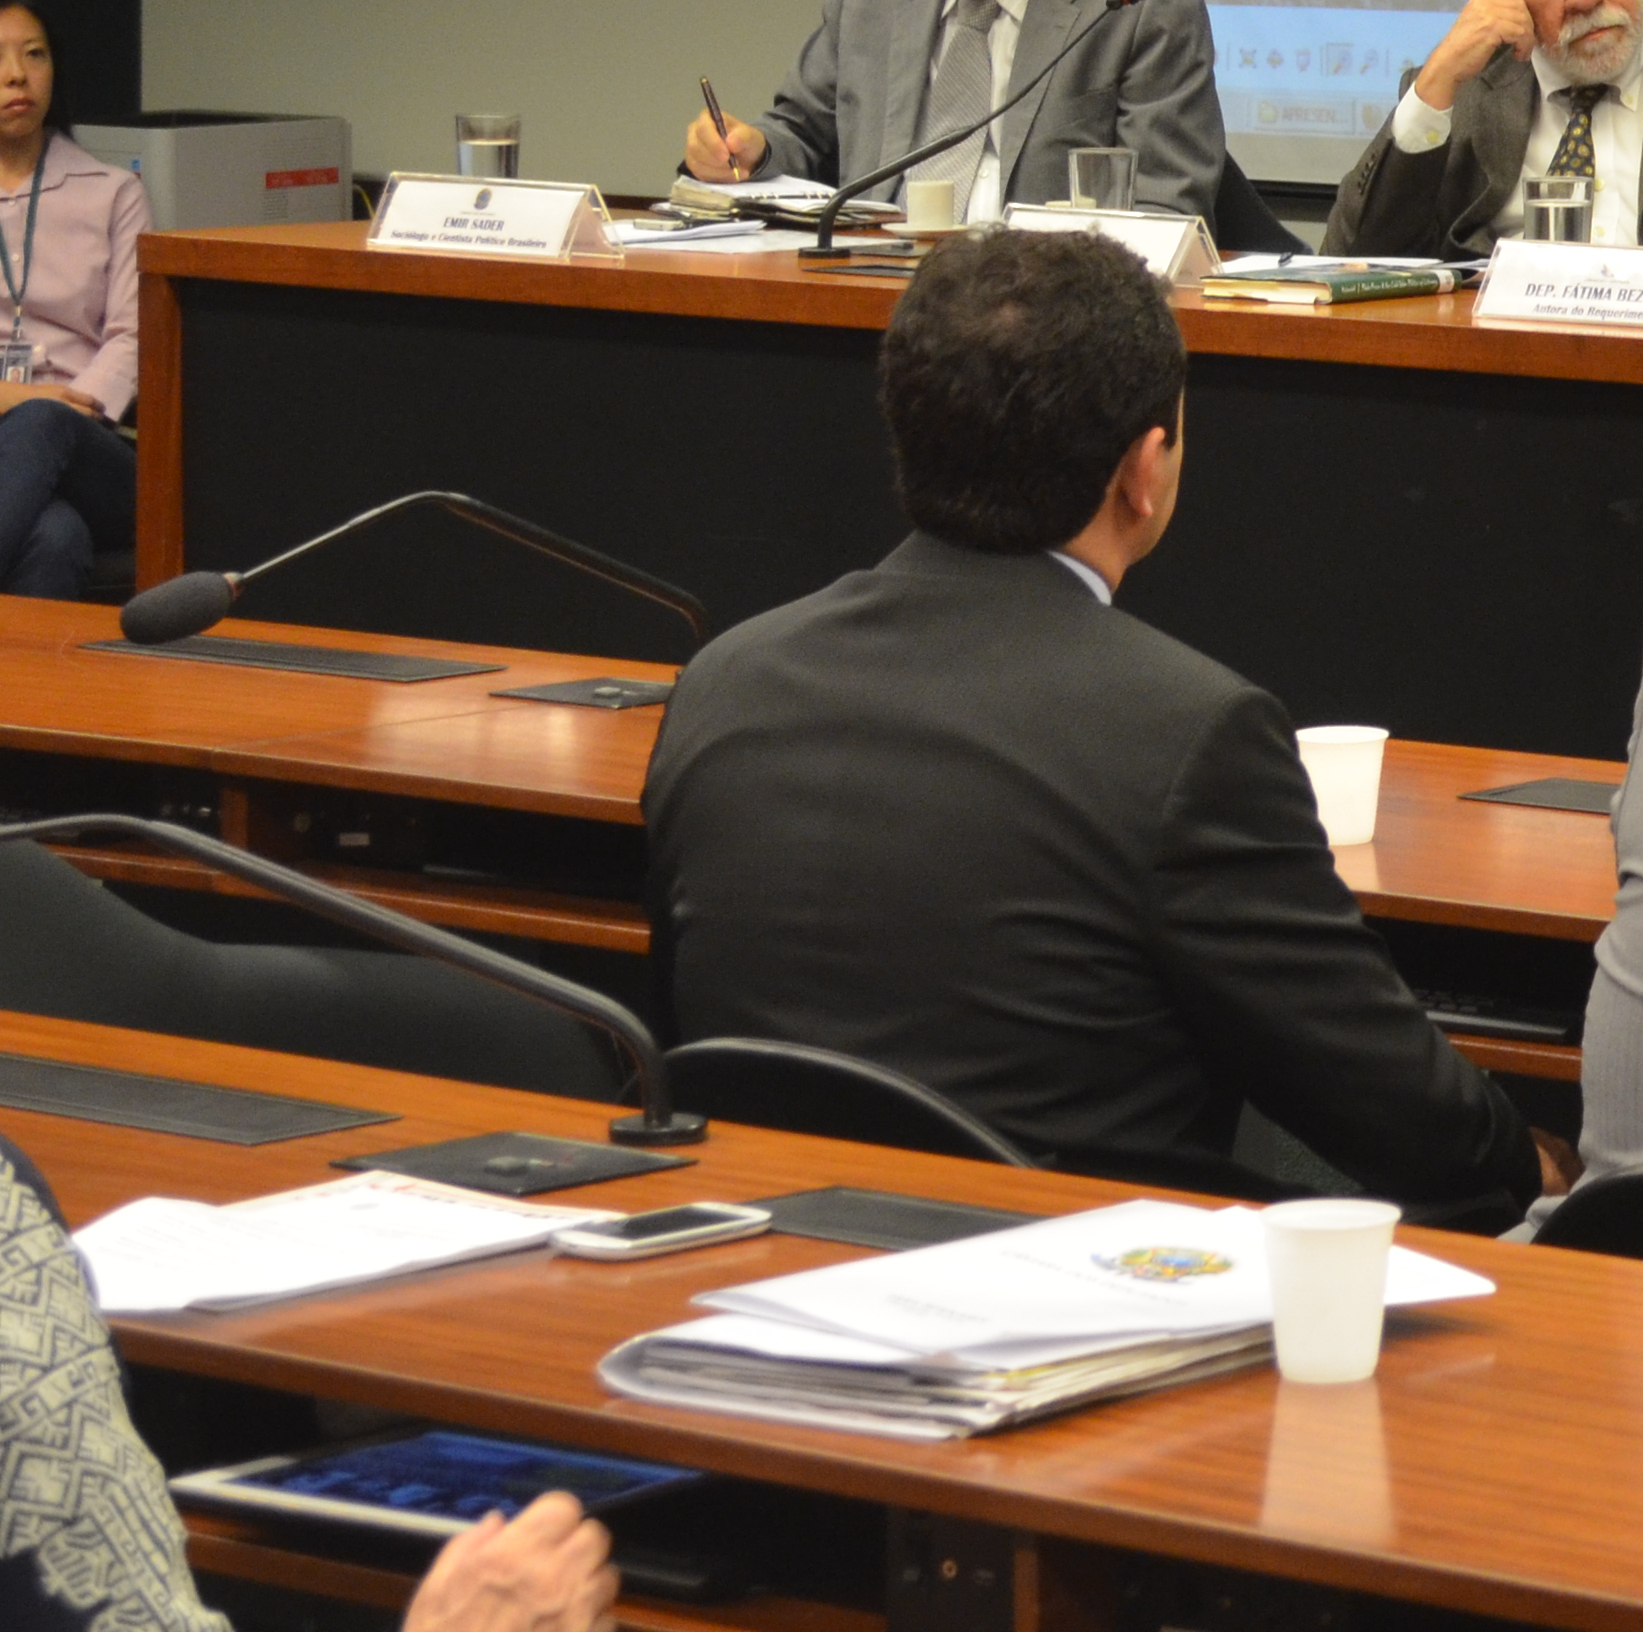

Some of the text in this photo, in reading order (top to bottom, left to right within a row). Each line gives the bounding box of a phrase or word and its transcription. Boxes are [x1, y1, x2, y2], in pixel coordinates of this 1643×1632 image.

[443, 217, 505, 232] EMIR SADER
[1525, 283, 1557, 299] DEP.
[1562, 282, 1614, 302] FÁTIMA
[1533, 303, 1567, 315] Autora
[1571, 306, 1584, 317] do
